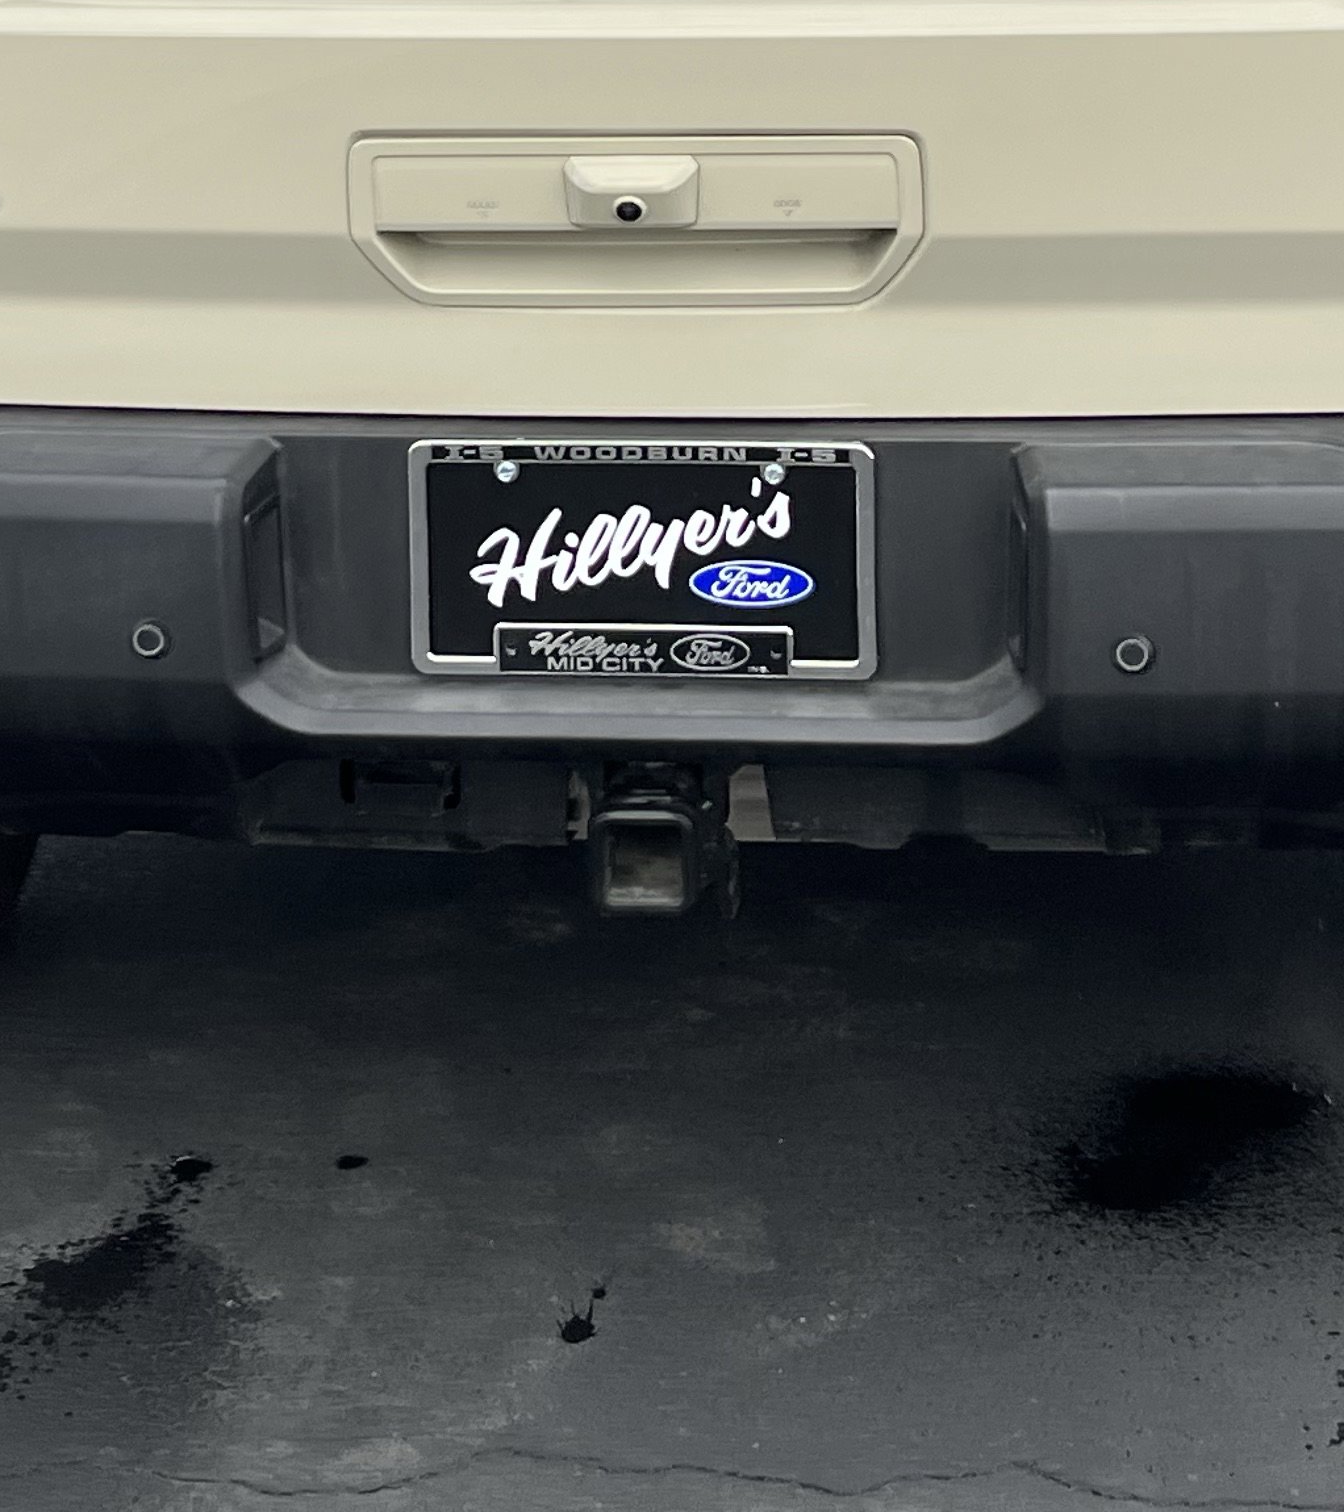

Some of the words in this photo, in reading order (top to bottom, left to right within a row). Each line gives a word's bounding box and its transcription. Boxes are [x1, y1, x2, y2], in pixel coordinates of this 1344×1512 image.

[444, 445, 504, 461] I-5
[534, 445, 747, 462] WOODBURN
[775, 447, 837, 463] I-5
[469, 476, 791, 608] Hillyer's
[709, 564, 791, 600] Ford
[528, 629, 659, 663] Hillyer's
[684, 638, 736, 665] Ford
[547, 656, 603, 673] MID
[610, 656, 665, 673] CITY
